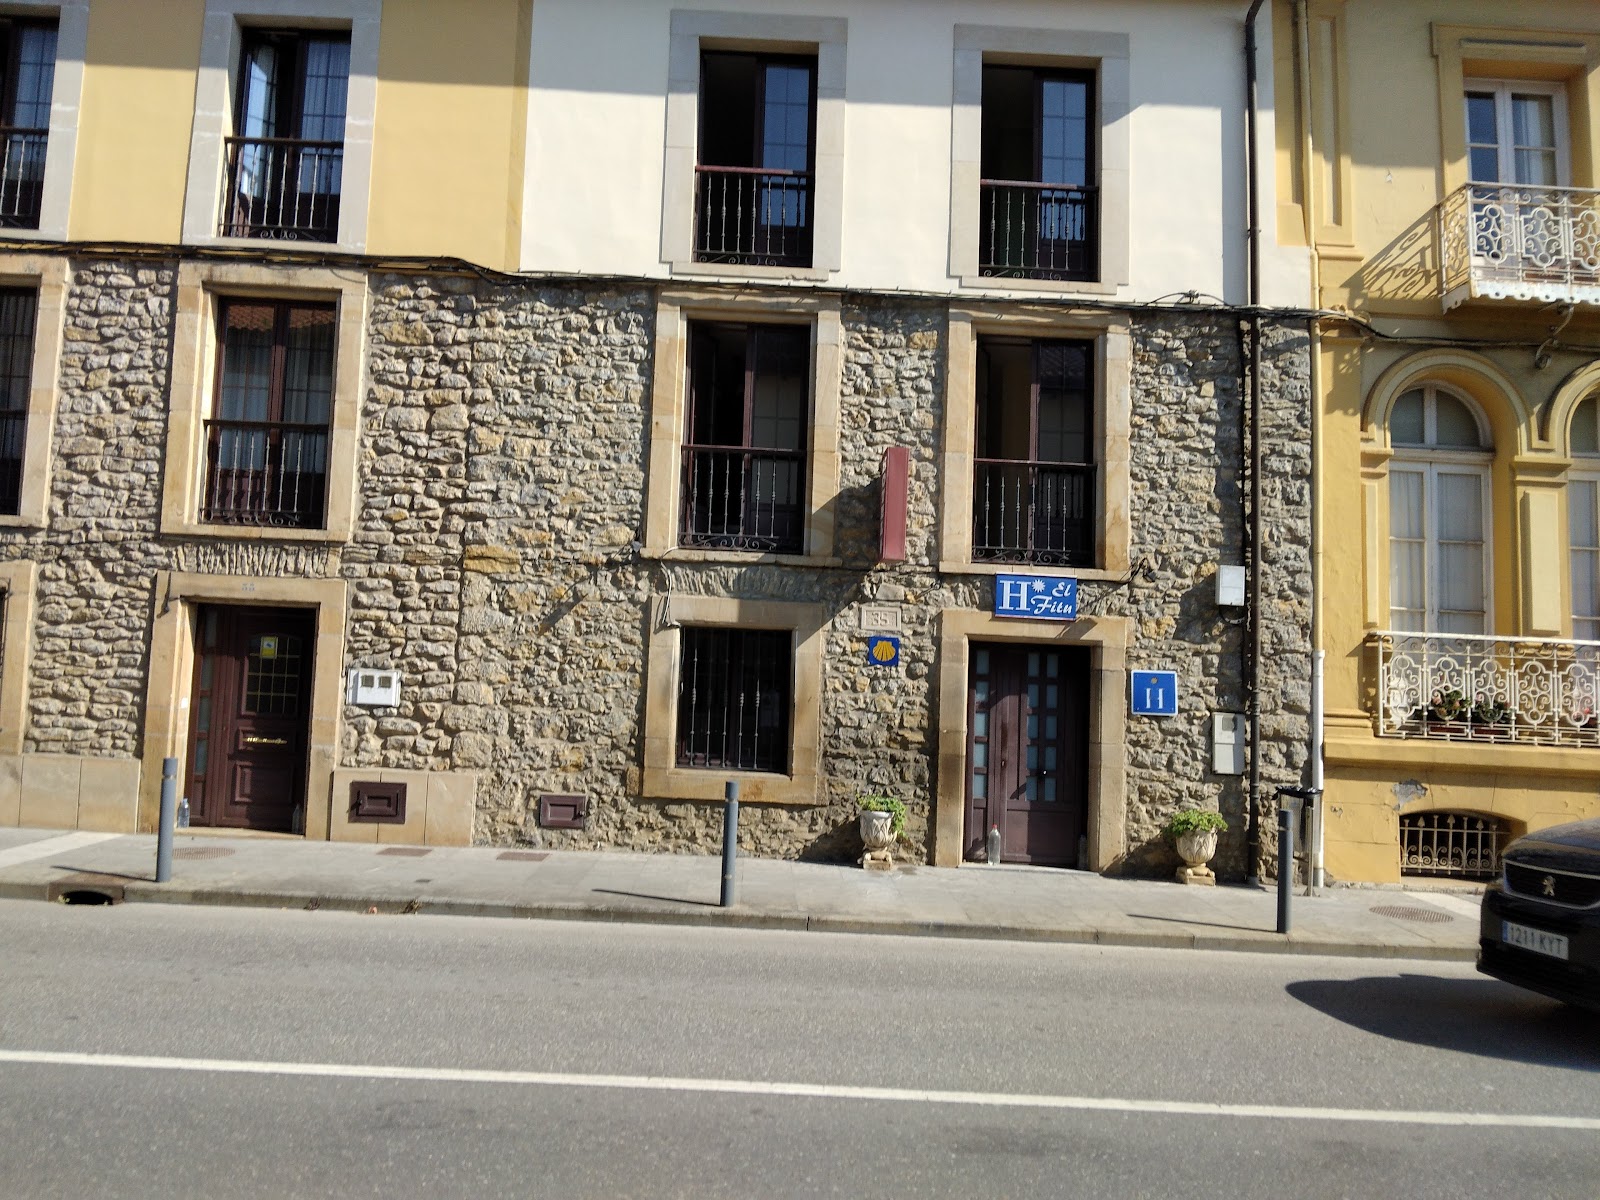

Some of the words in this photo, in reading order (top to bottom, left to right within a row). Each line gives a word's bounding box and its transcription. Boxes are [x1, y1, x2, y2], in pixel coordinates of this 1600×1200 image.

[998, 580, 1031, 611] H
[1052, 581, 1072, 597] El
[1031, 595, 1073, 615] Fitu
[871, 610, 890, 627] 35
[1510, 925, 1535, 948] 1211
[1539, 933, 1563, 955] KYT
